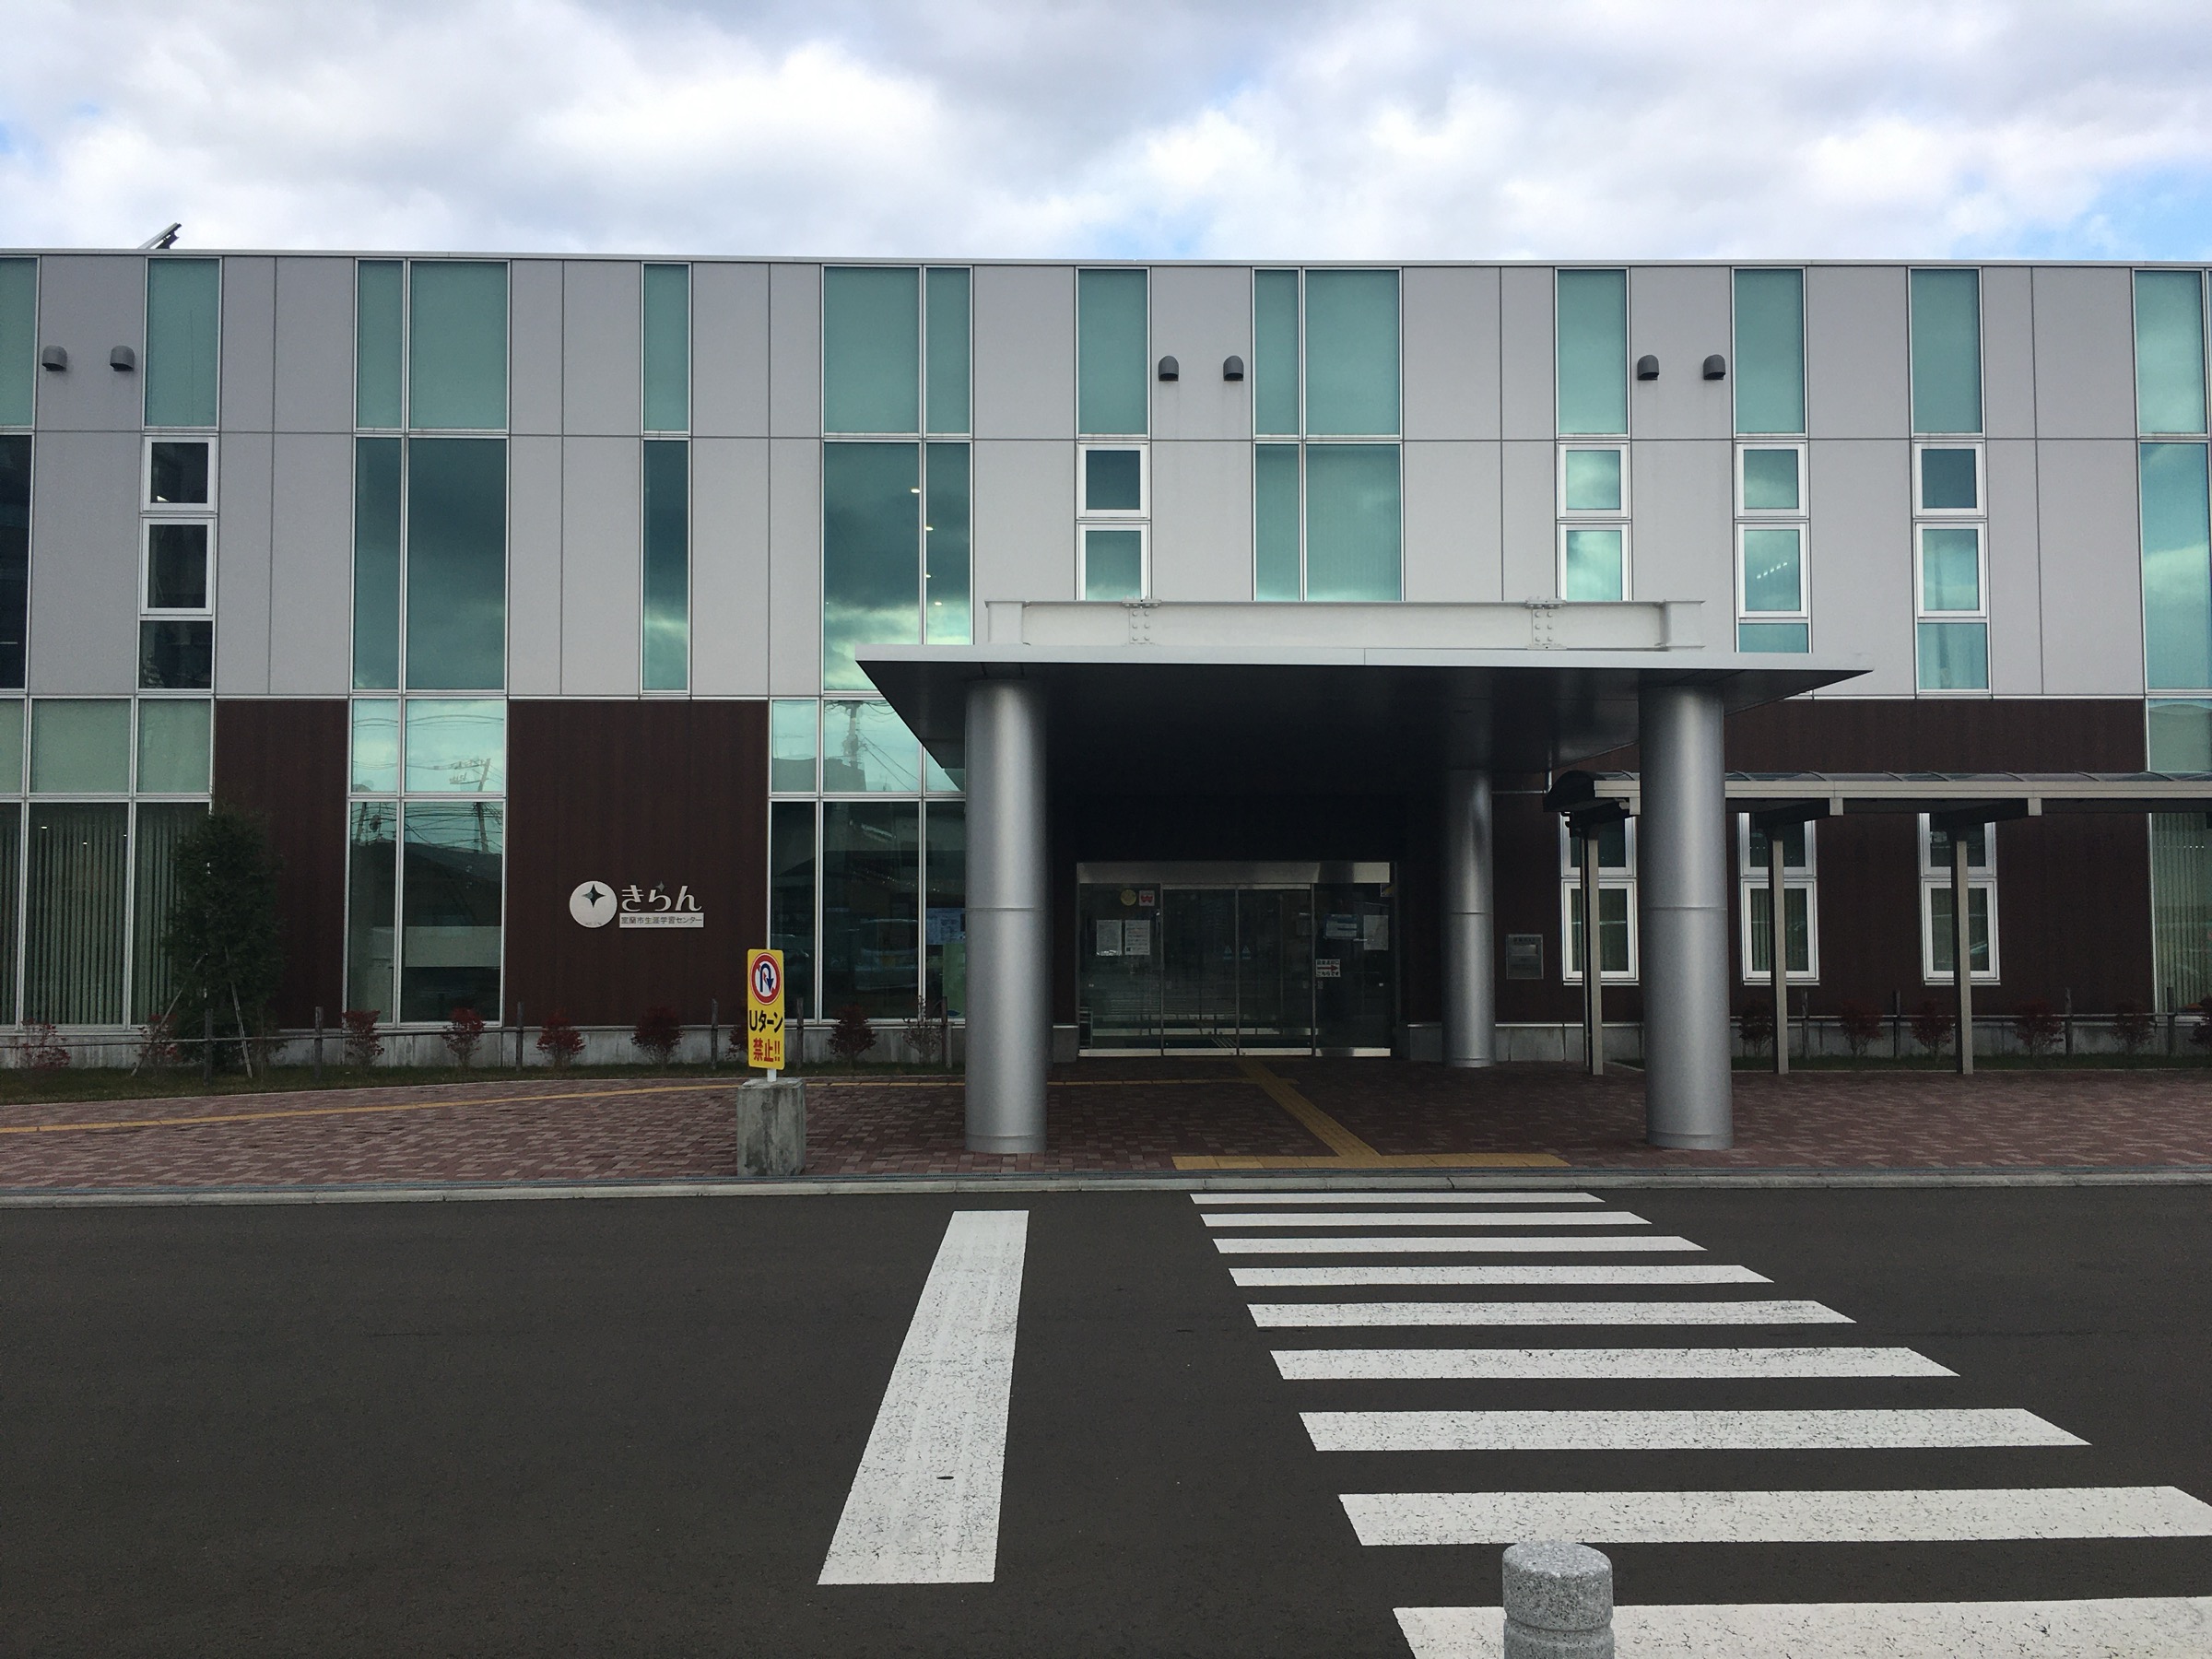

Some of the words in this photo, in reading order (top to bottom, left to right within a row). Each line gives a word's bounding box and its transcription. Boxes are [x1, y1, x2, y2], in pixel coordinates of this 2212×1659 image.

[621, 882, 702, 912] きらん
[621, 916, 702, 924] 室蘭市生涯学習センター
[749, 1010, 783, 1033] Uターン
[753, 1038, 781, 1062] 禁止!!
